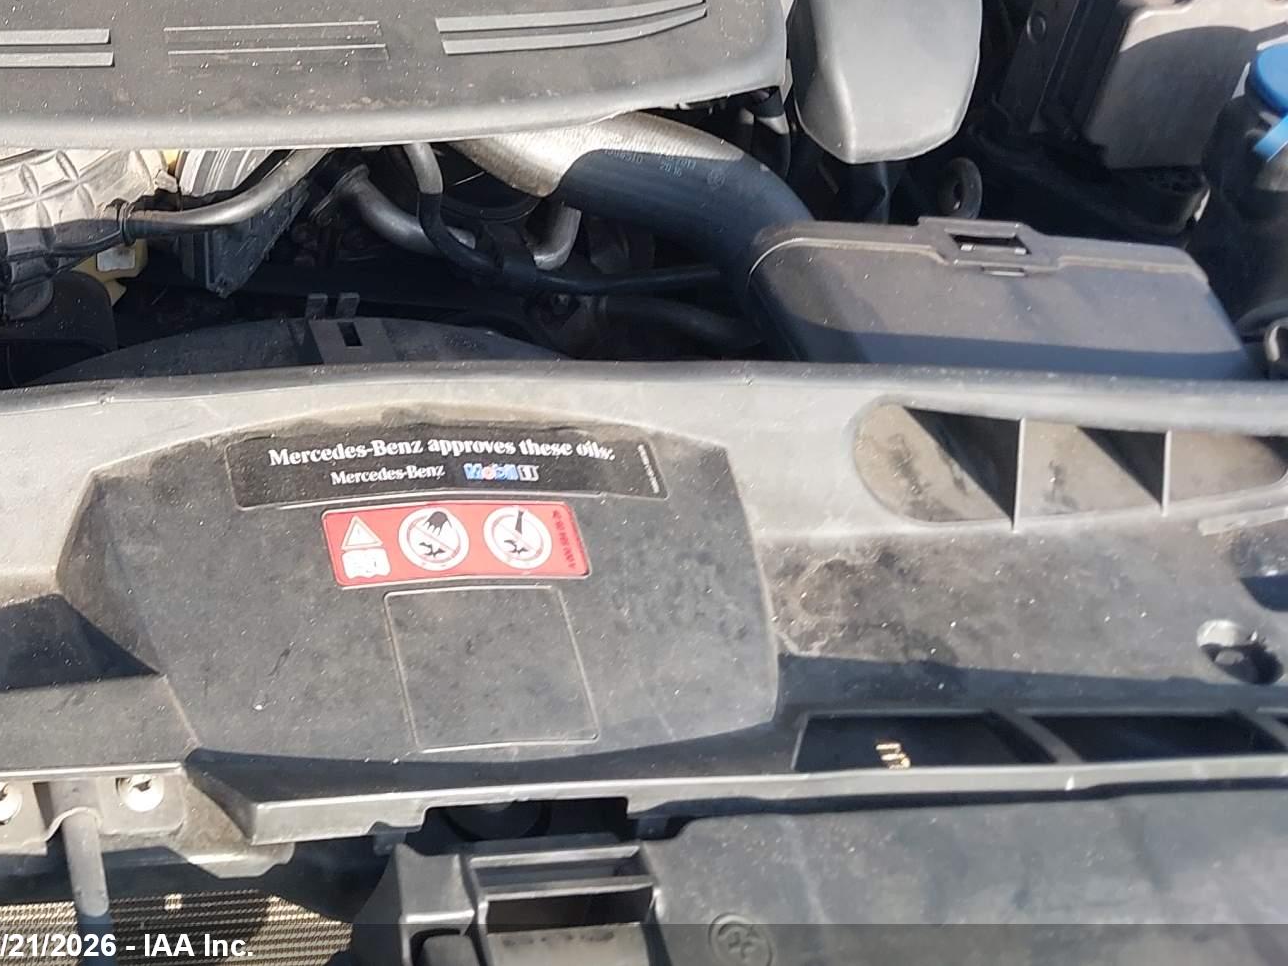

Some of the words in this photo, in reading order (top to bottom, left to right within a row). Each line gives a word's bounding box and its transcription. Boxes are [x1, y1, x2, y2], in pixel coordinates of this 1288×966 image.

[268, 439, 424, 467] Mercedes-Benz
[427, 438, 517, 457] approves
[518, 439, 573, 457] these
[330, 464, 446, 486] Mercedes-Benz
